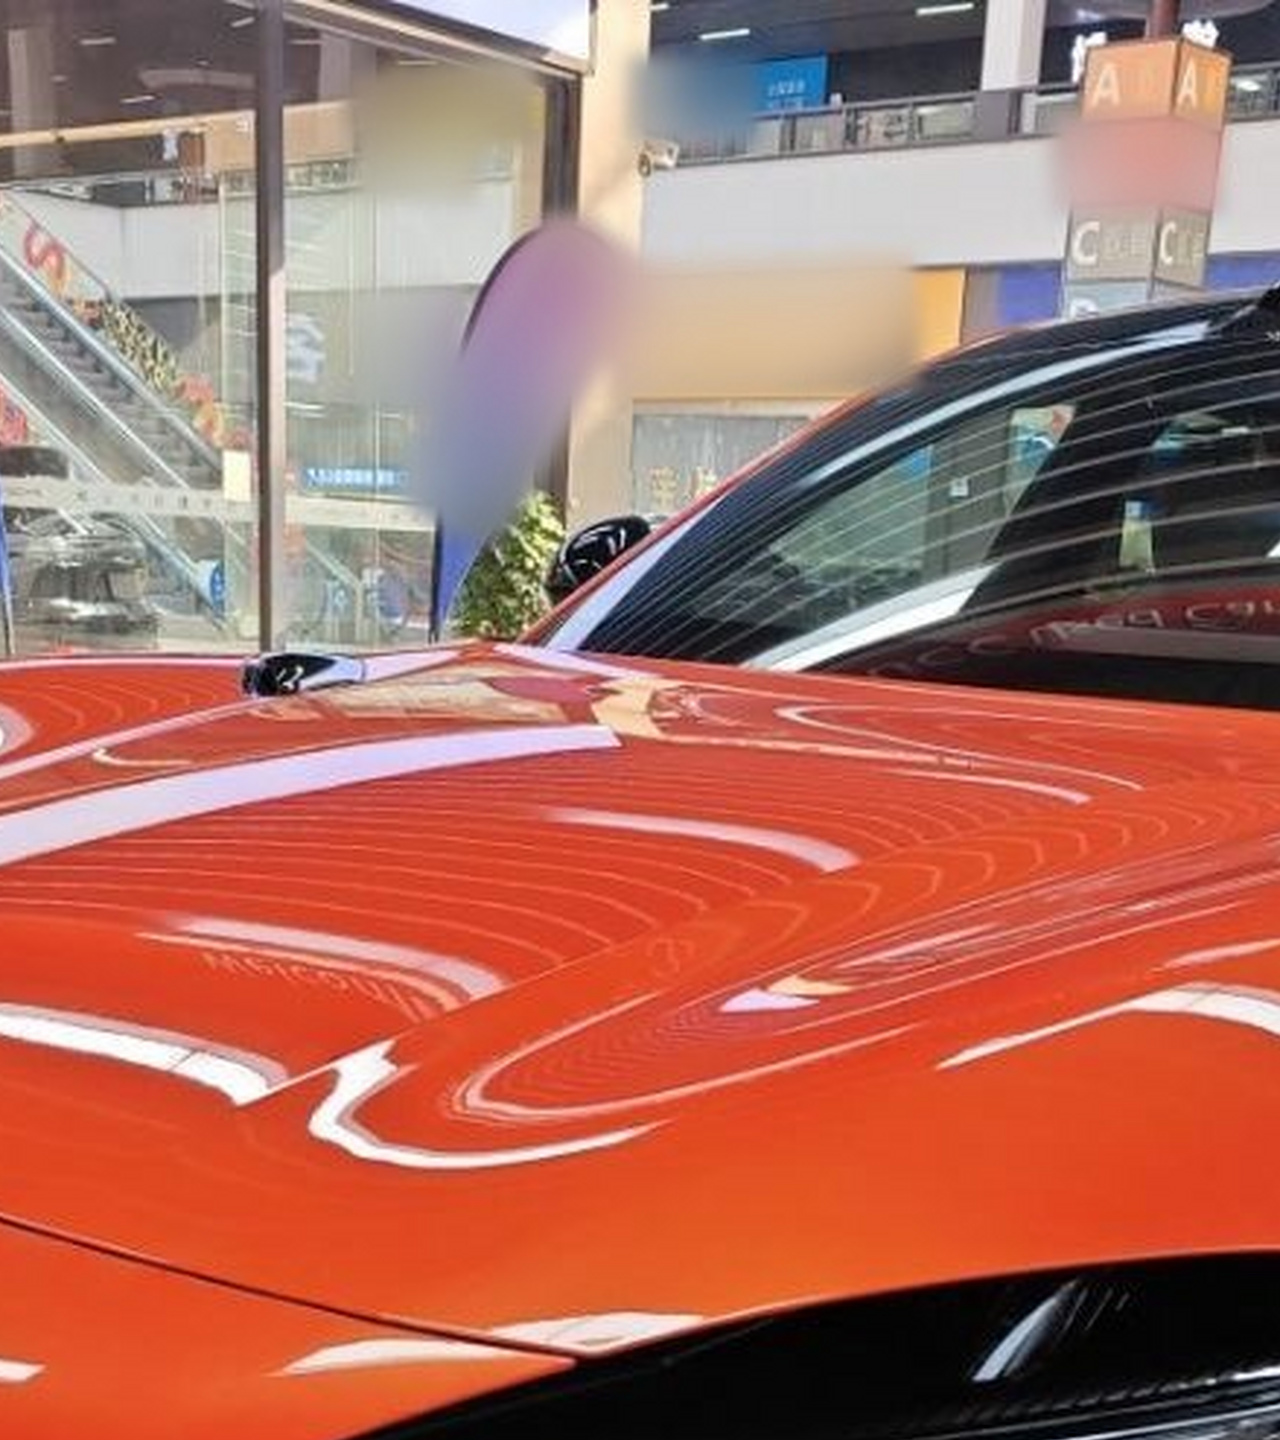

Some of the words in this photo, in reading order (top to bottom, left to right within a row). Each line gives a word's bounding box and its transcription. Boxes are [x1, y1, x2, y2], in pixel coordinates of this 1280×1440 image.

[1093, 62, 1119, 108] A
[1177, 57, 1198, 109] A
[1073, 220, 1100, 266] C
[1160, 220, 1177, 266] C
